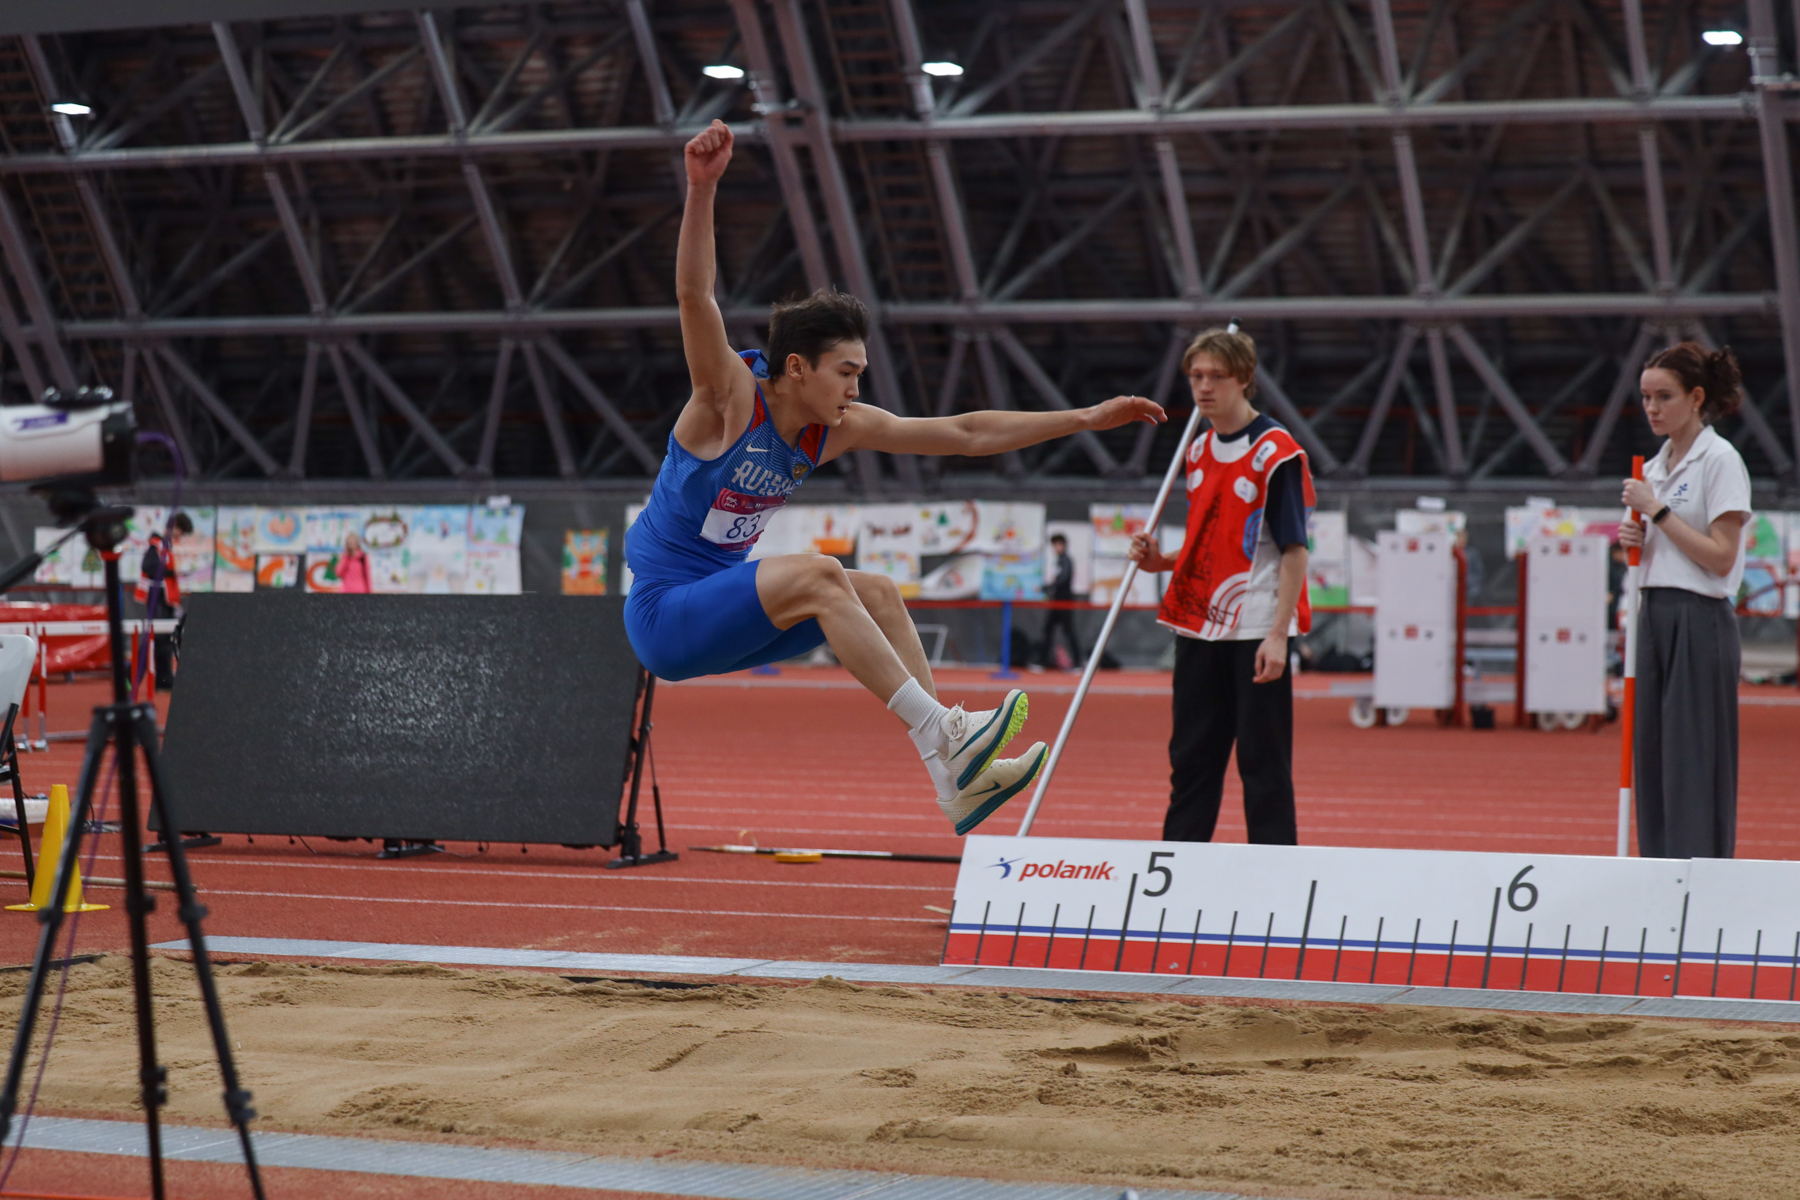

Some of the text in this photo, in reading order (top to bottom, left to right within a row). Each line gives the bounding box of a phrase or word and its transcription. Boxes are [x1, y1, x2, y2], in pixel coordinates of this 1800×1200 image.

[726, 514, 761, 539] 83
[1018, 859, 1115, 882] polanik
[1142, 851, 1175, 897] 5
[1507, 864, 1539, 912] 6
